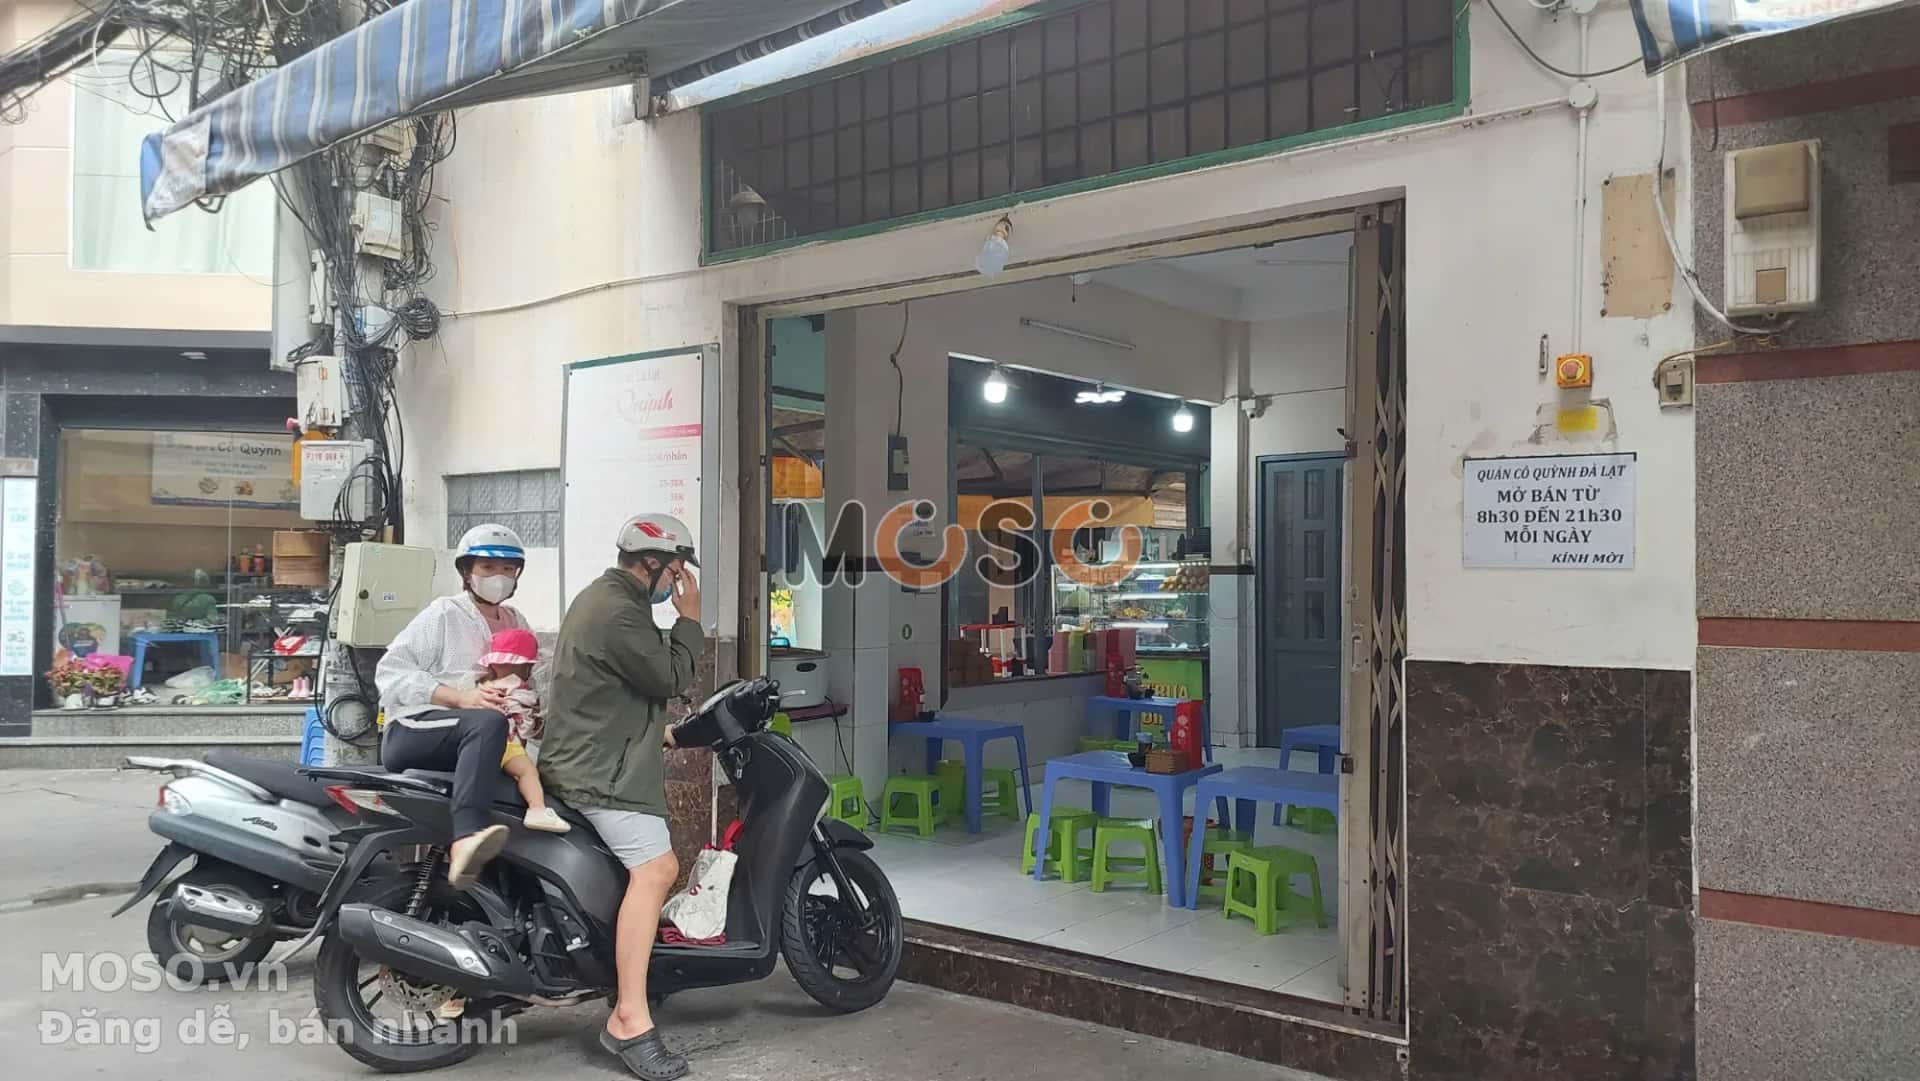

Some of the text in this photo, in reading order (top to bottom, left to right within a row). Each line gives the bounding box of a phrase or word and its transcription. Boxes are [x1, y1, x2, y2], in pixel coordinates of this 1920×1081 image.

[1477, 466, 1512, 482] QUÁN
[1514, 466, 1529, 480] CÔ
[1600, 464, 1627, 479] LẠT
[1497, 485, 1601, 503] MỞ BÁN TỪ
[1477, 506, 1622, 524] 8h30 ĐẾN 21h30
[1504, 525, 1592, 543] MỖI NGÀY
[1552, 551, 1624, 564] KÍNH MỜI
